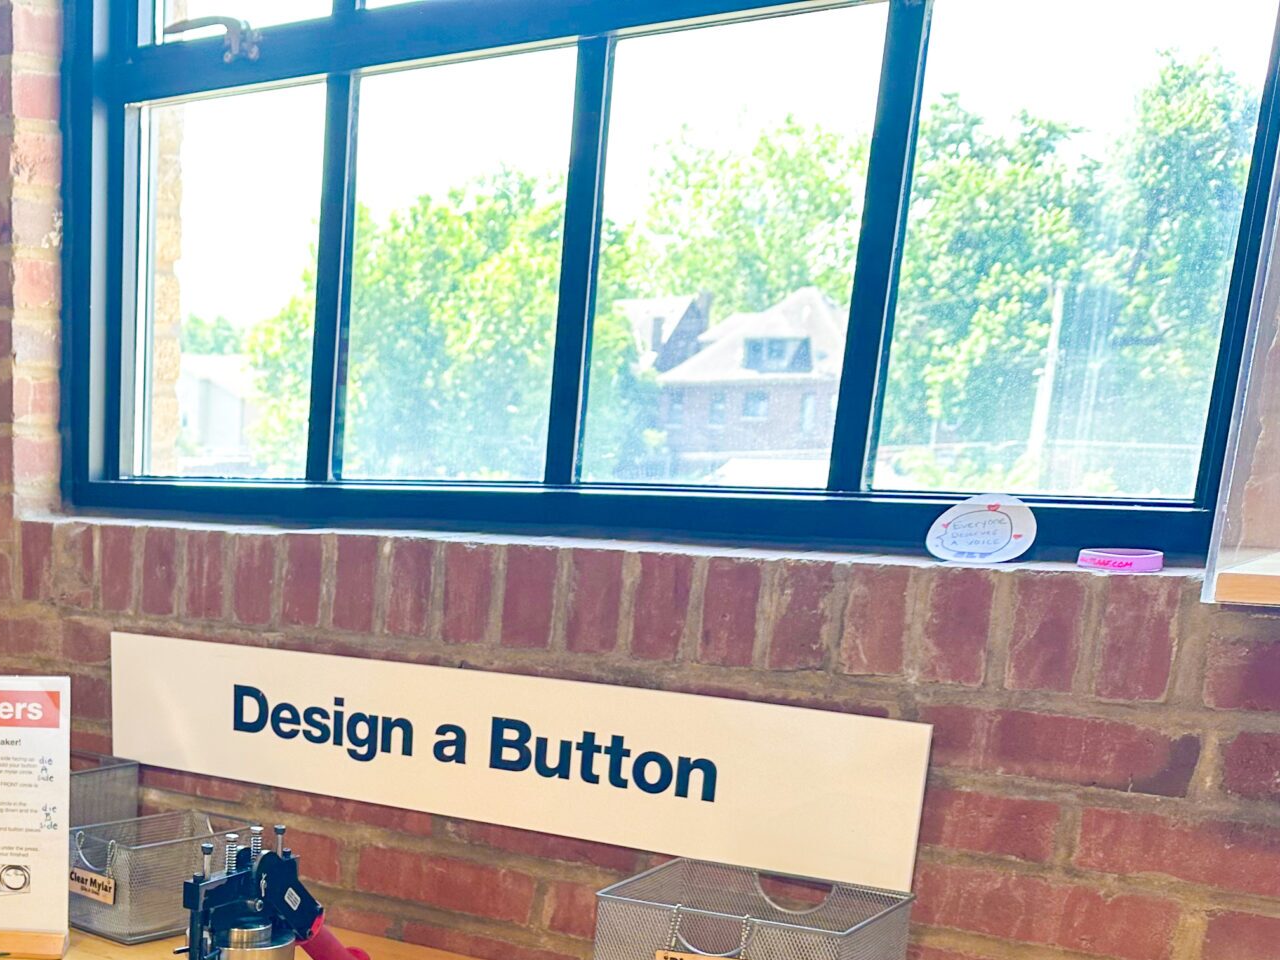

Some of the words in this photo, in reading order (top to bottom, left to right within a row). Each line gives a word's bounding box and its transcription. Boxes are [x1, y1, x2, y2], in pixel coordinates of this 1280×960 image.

[232, 683, 414, 762] Design
[434, 723, 467, 765] a
[488, 717, 719, 803] Button
[70, 871, 88, 885] Clear
[90, 877, 113, 893] Mylar
